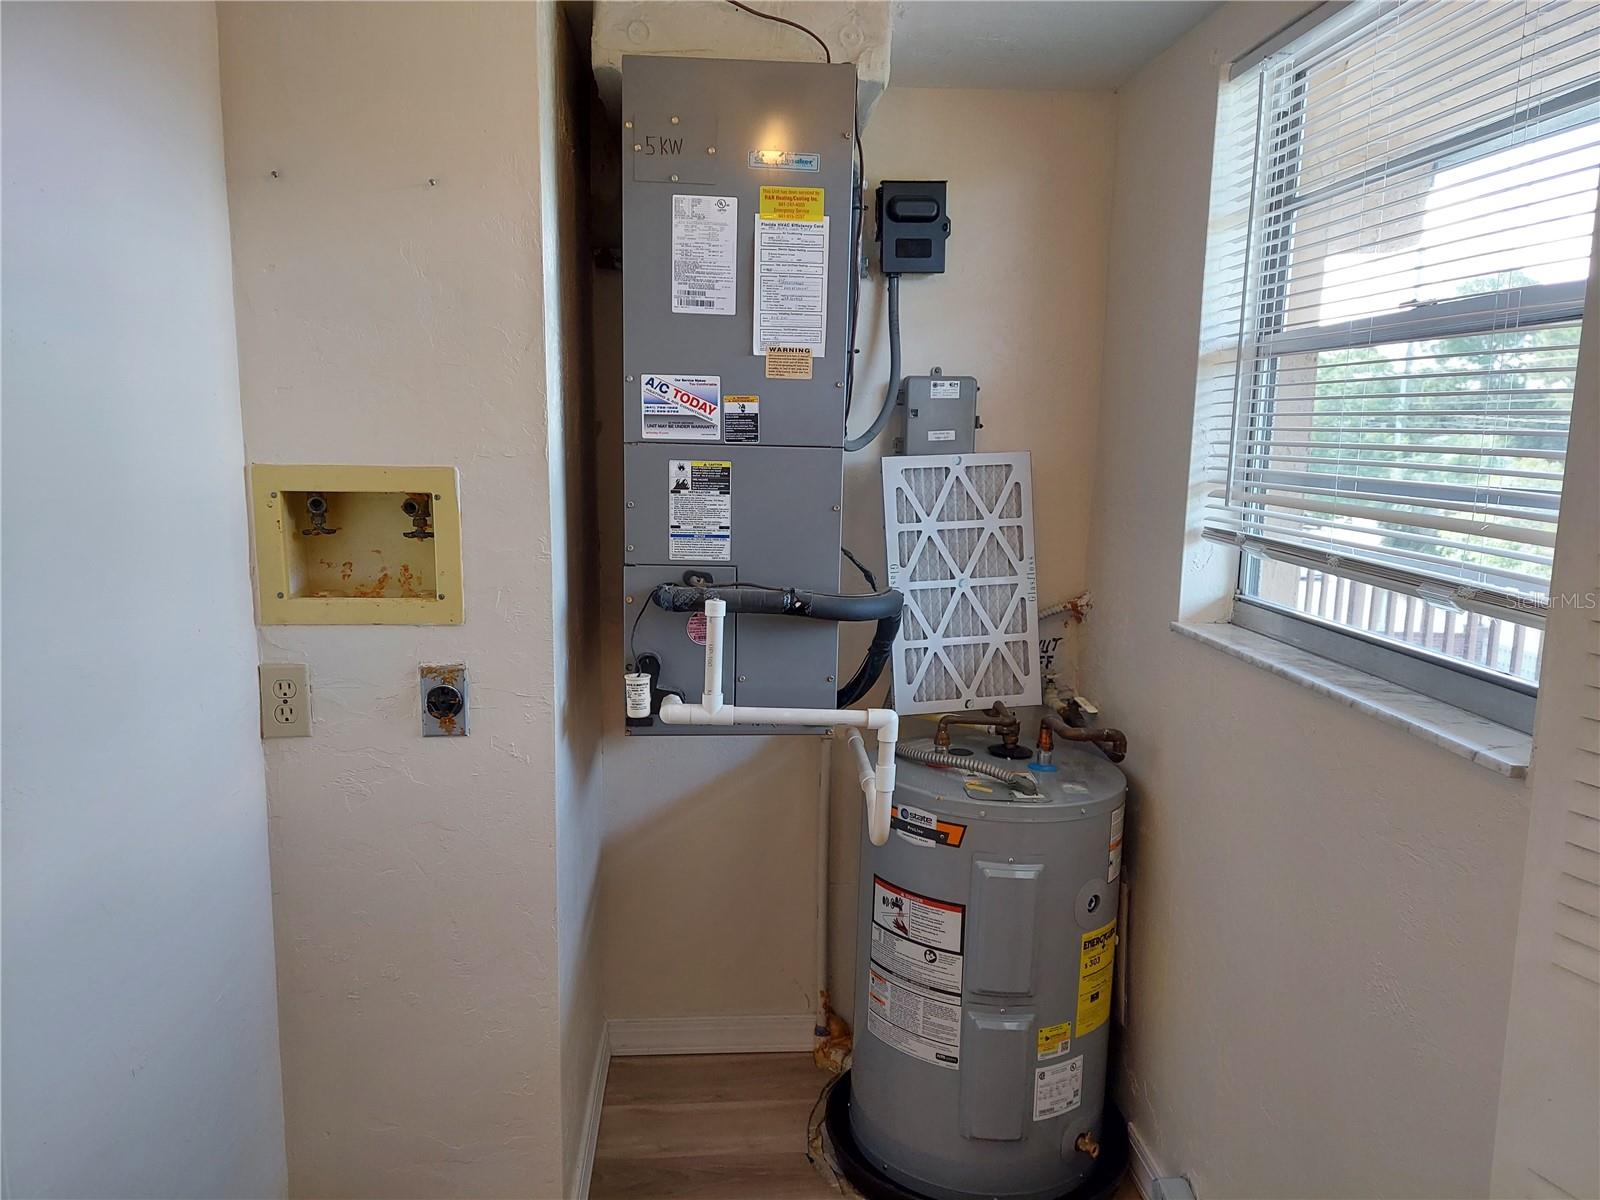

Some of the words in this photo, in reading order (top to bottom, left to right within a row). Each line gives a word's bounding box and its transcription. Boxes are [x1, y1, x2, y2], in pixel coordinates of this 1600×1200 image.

[645, 136, 655, 155] 5
[660, 136, 683, 155] KW
[645, 377, 670, 394] A/C
[673, 388, 717, 415] TODAY
[910, 812, 932, 824] state
